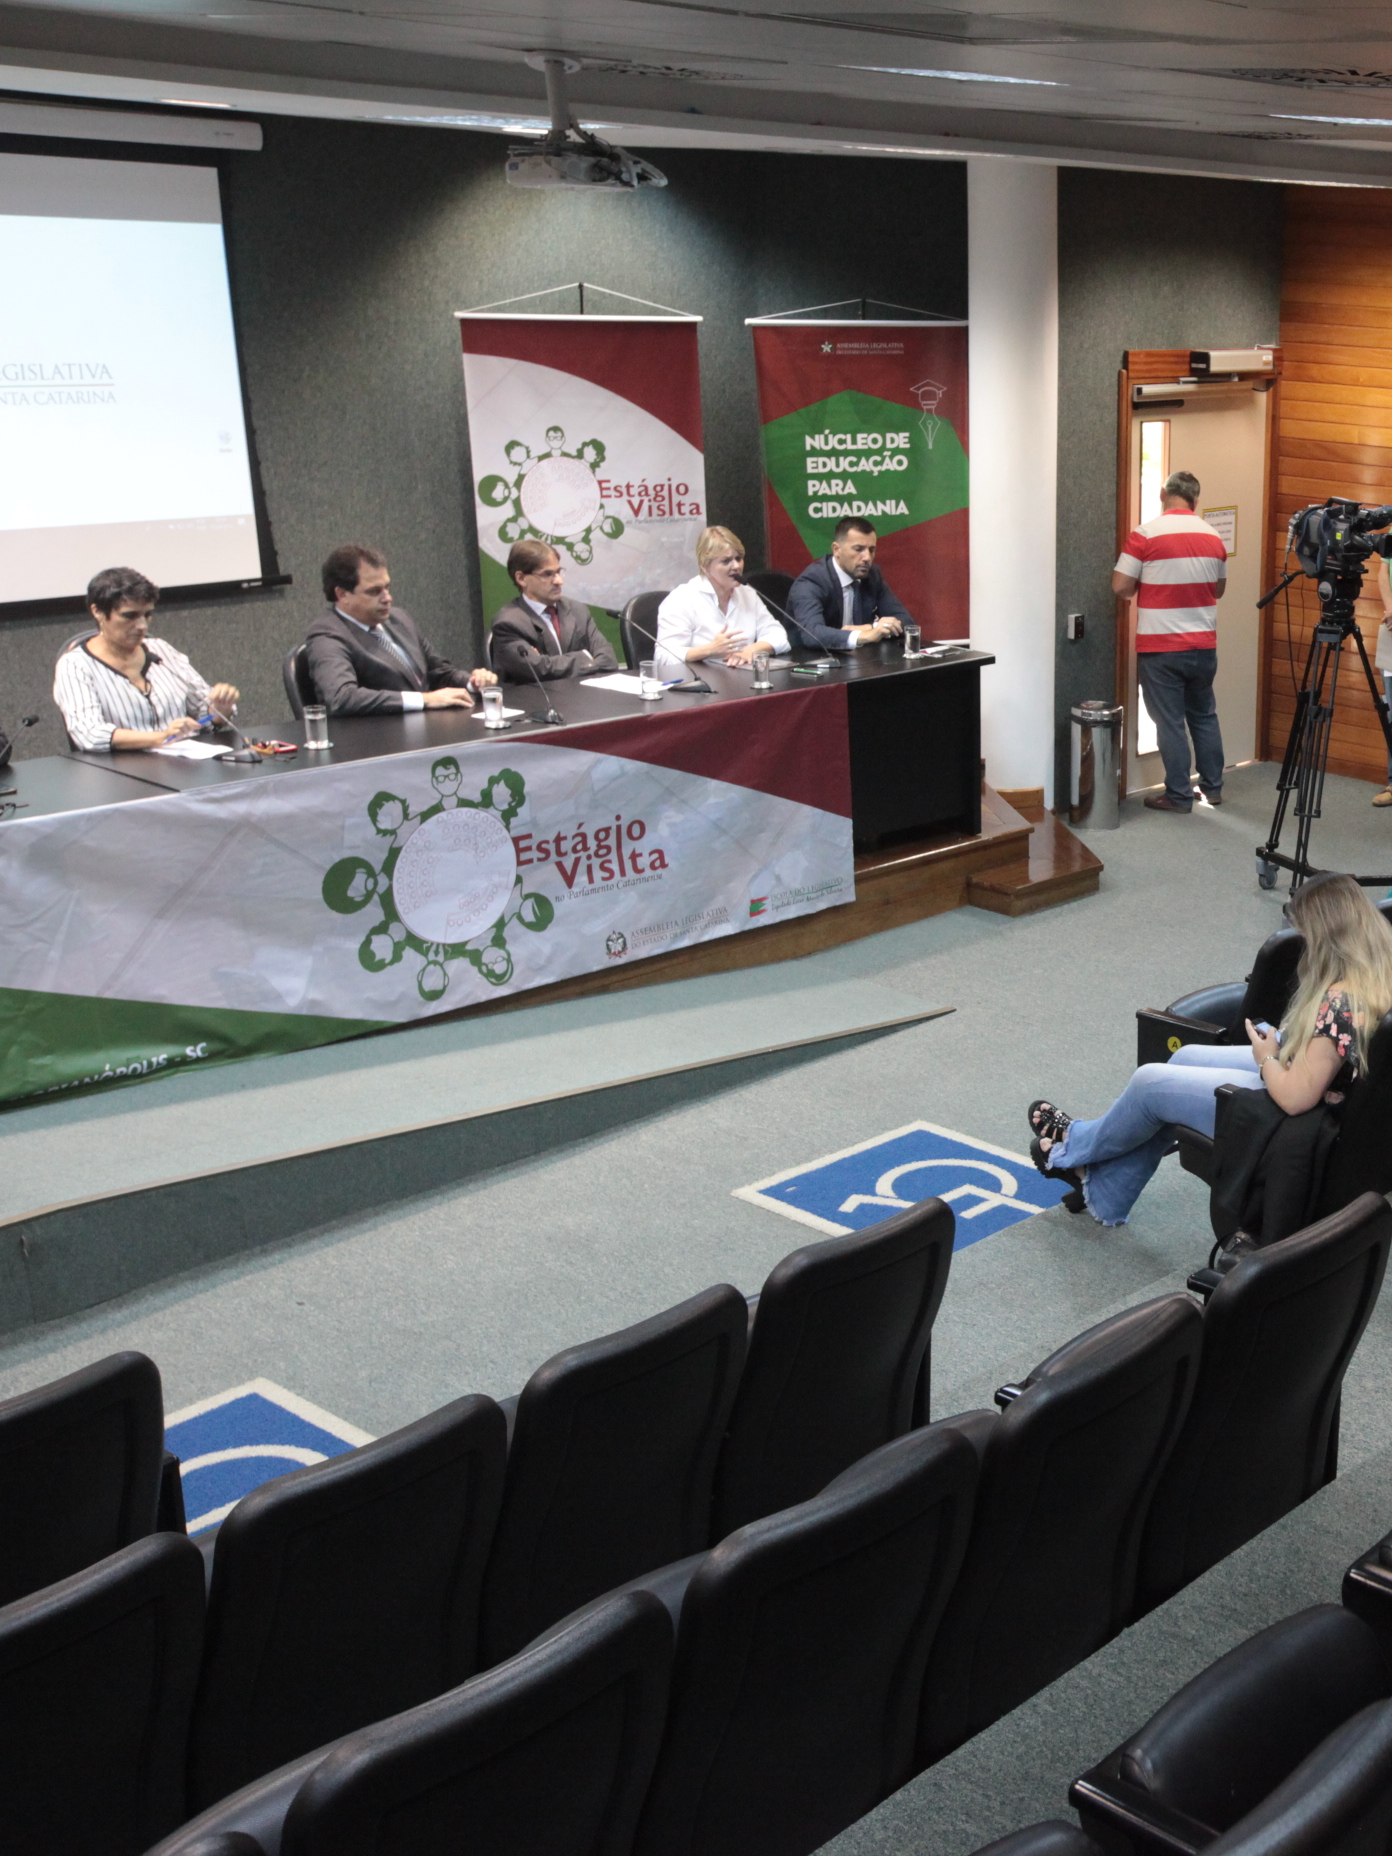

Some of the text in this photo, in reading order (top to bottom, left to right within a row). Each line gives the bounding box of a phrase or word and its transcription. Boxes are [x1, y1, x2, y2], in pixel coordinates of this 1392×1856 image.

[0, 362, 113, 381] GISLATIVA
[33, 390, 117, 405] CATARINA
[805, 429, 911, 451] NÚCLEO DE
[806, 451, 908, 476] EDUCAÇÃO
[597, 477, 689, 503] Estágio
[807, 479, 857, 496] PARA
[626, 498, 703, 518] Visita
[808, 500, 909, 518] CIDADANIA
[511, 814, 646, 867] Estágio
[554, 847, 669, 890] Visita
[555, 873, 664, 902] no Parlamento Catarinense
[770, 890, 793, 902] ESCOLA
[794, 887, 805, 896] DO
[630, 906, 729, 940] ASSEMBLEIA LEGISLATIVA
[631, 917, 730, 950] DO ESTADO DE SANTA CATARINA
[185, 1042, 208, 1061] SC
[1171, 1040, 1179, 1049] A
